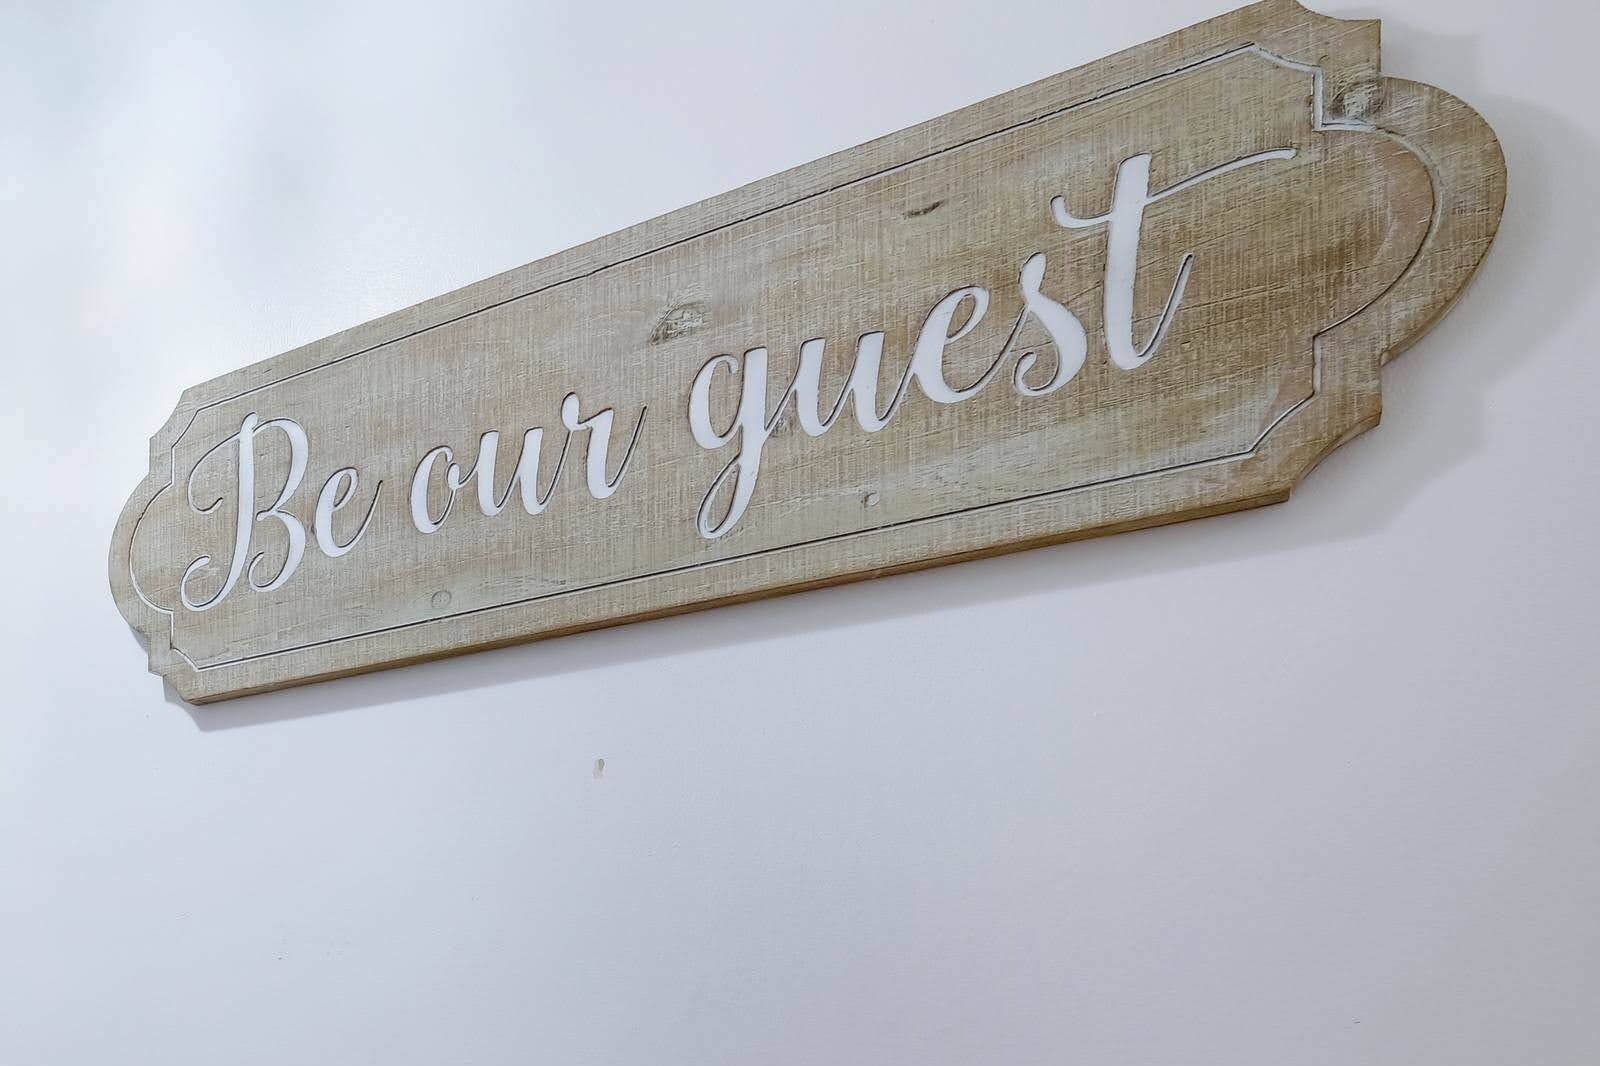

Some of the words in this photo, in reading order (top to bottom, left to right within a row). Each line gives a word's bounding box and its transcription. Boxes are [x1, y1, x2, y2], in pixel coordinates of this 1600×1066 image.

[180, 412, 383, 612] Be
[410, 391, 652, 535] our
[687, 148, 1297, 540] guest
